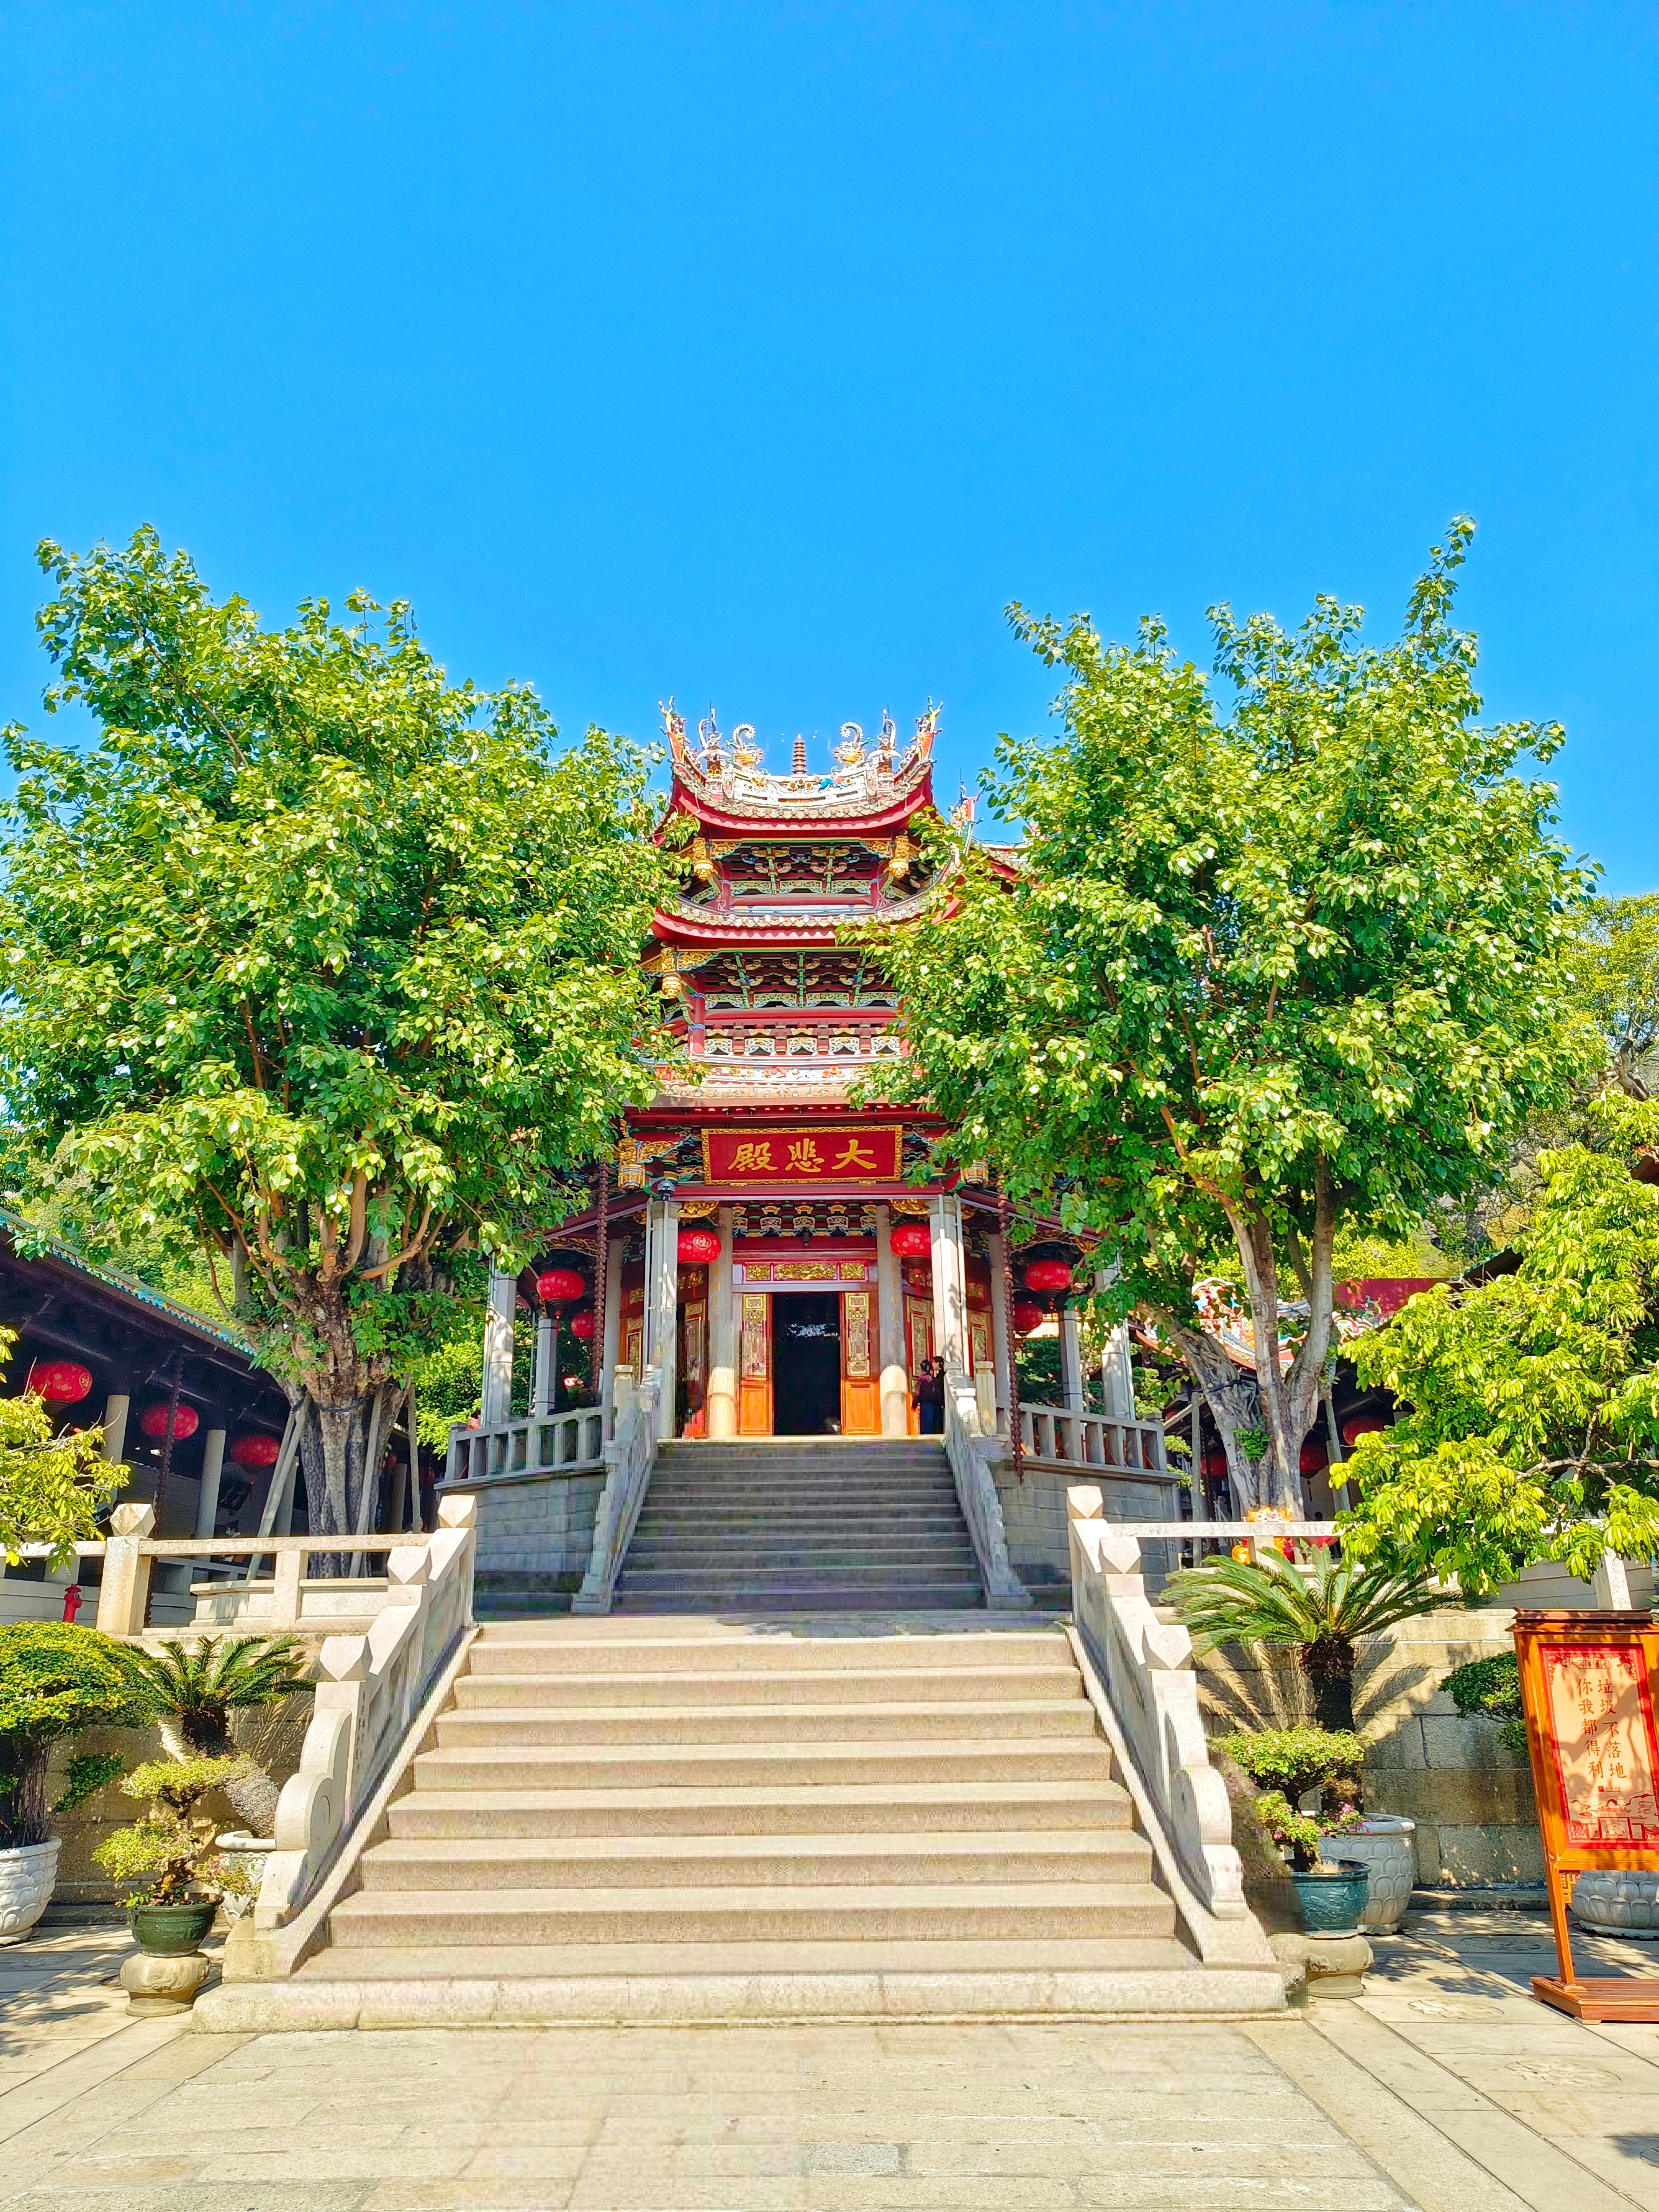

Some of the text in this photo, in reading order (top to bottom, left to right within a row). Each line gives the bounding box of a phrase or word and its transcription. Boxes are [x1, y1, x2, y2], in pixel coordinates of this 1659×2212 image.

[727, 1138, 877, 1173] 大悲殿
[1576, 1678, 1603, 1778] 你我都得利
[1597, 1679, 1627, 1778] 垃圾不落地
